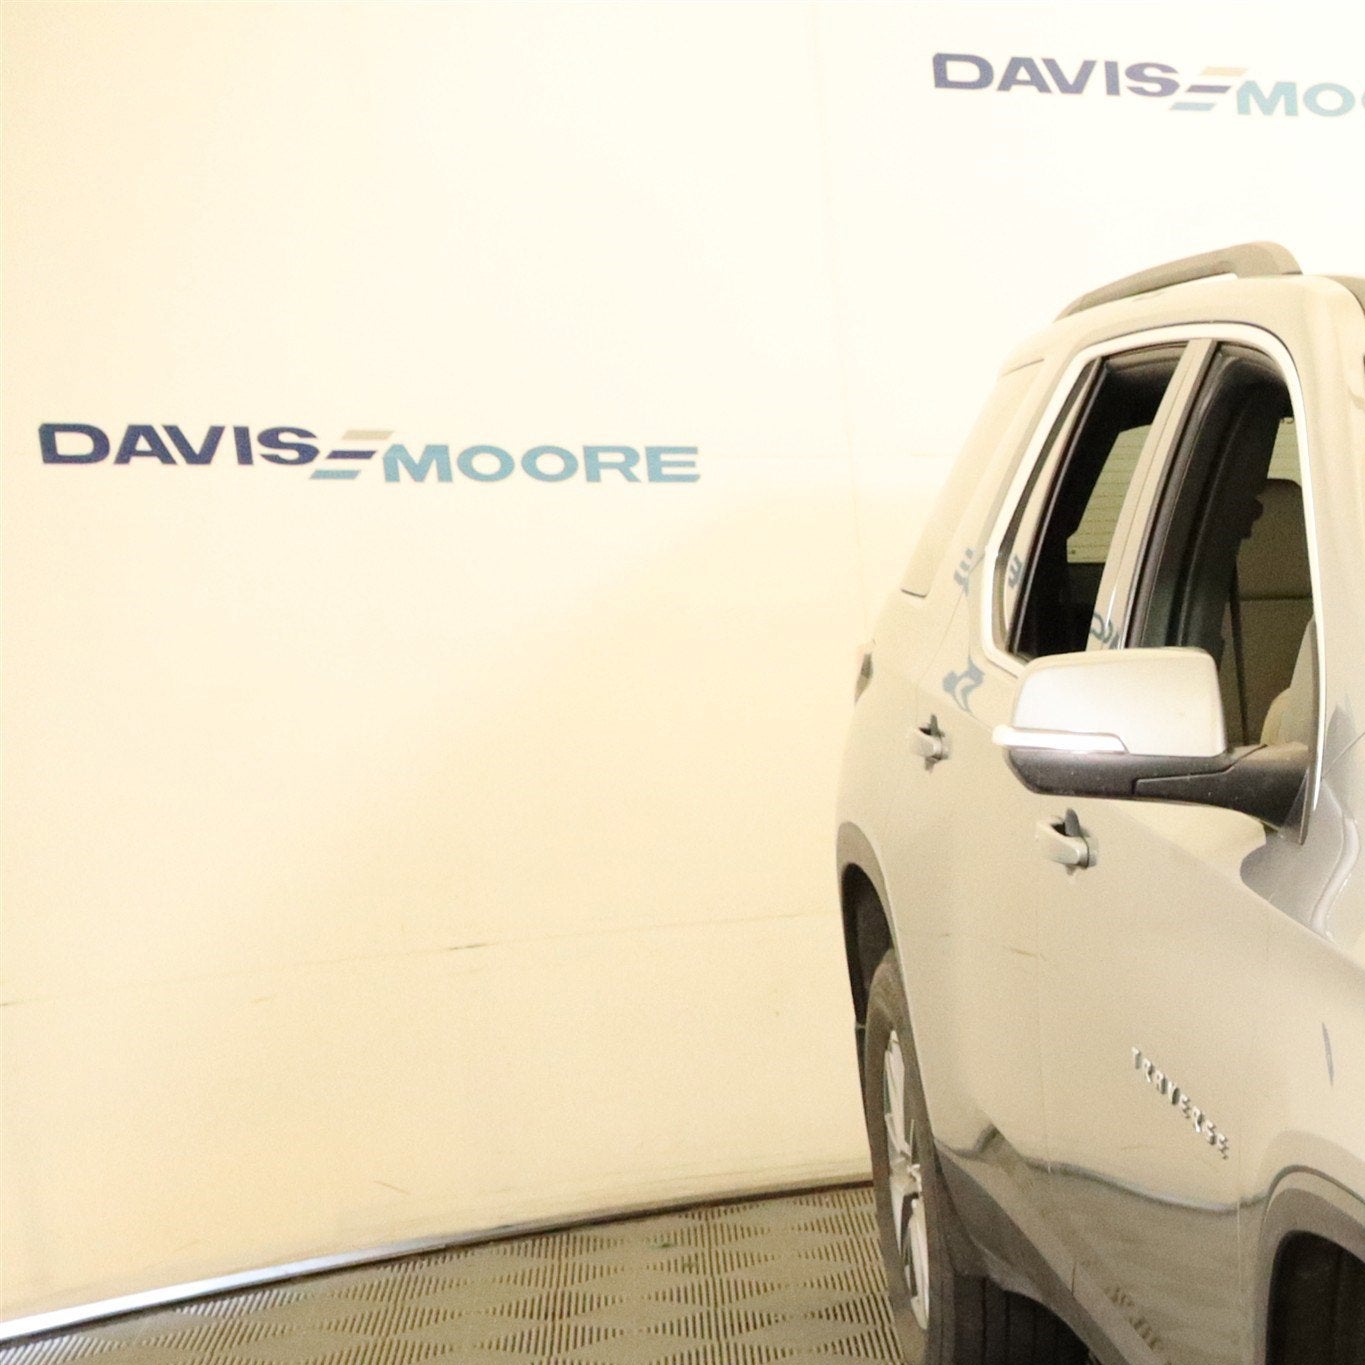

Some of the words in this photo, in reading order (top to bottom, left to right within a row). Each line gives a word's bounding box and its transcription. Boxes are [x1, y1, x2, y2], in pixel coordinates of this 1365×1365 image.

[933, 52, 1178, 98] DAVIS
[37, 422, 321, 466] DAVIS
[382, 442, 702, 483] MOORE
